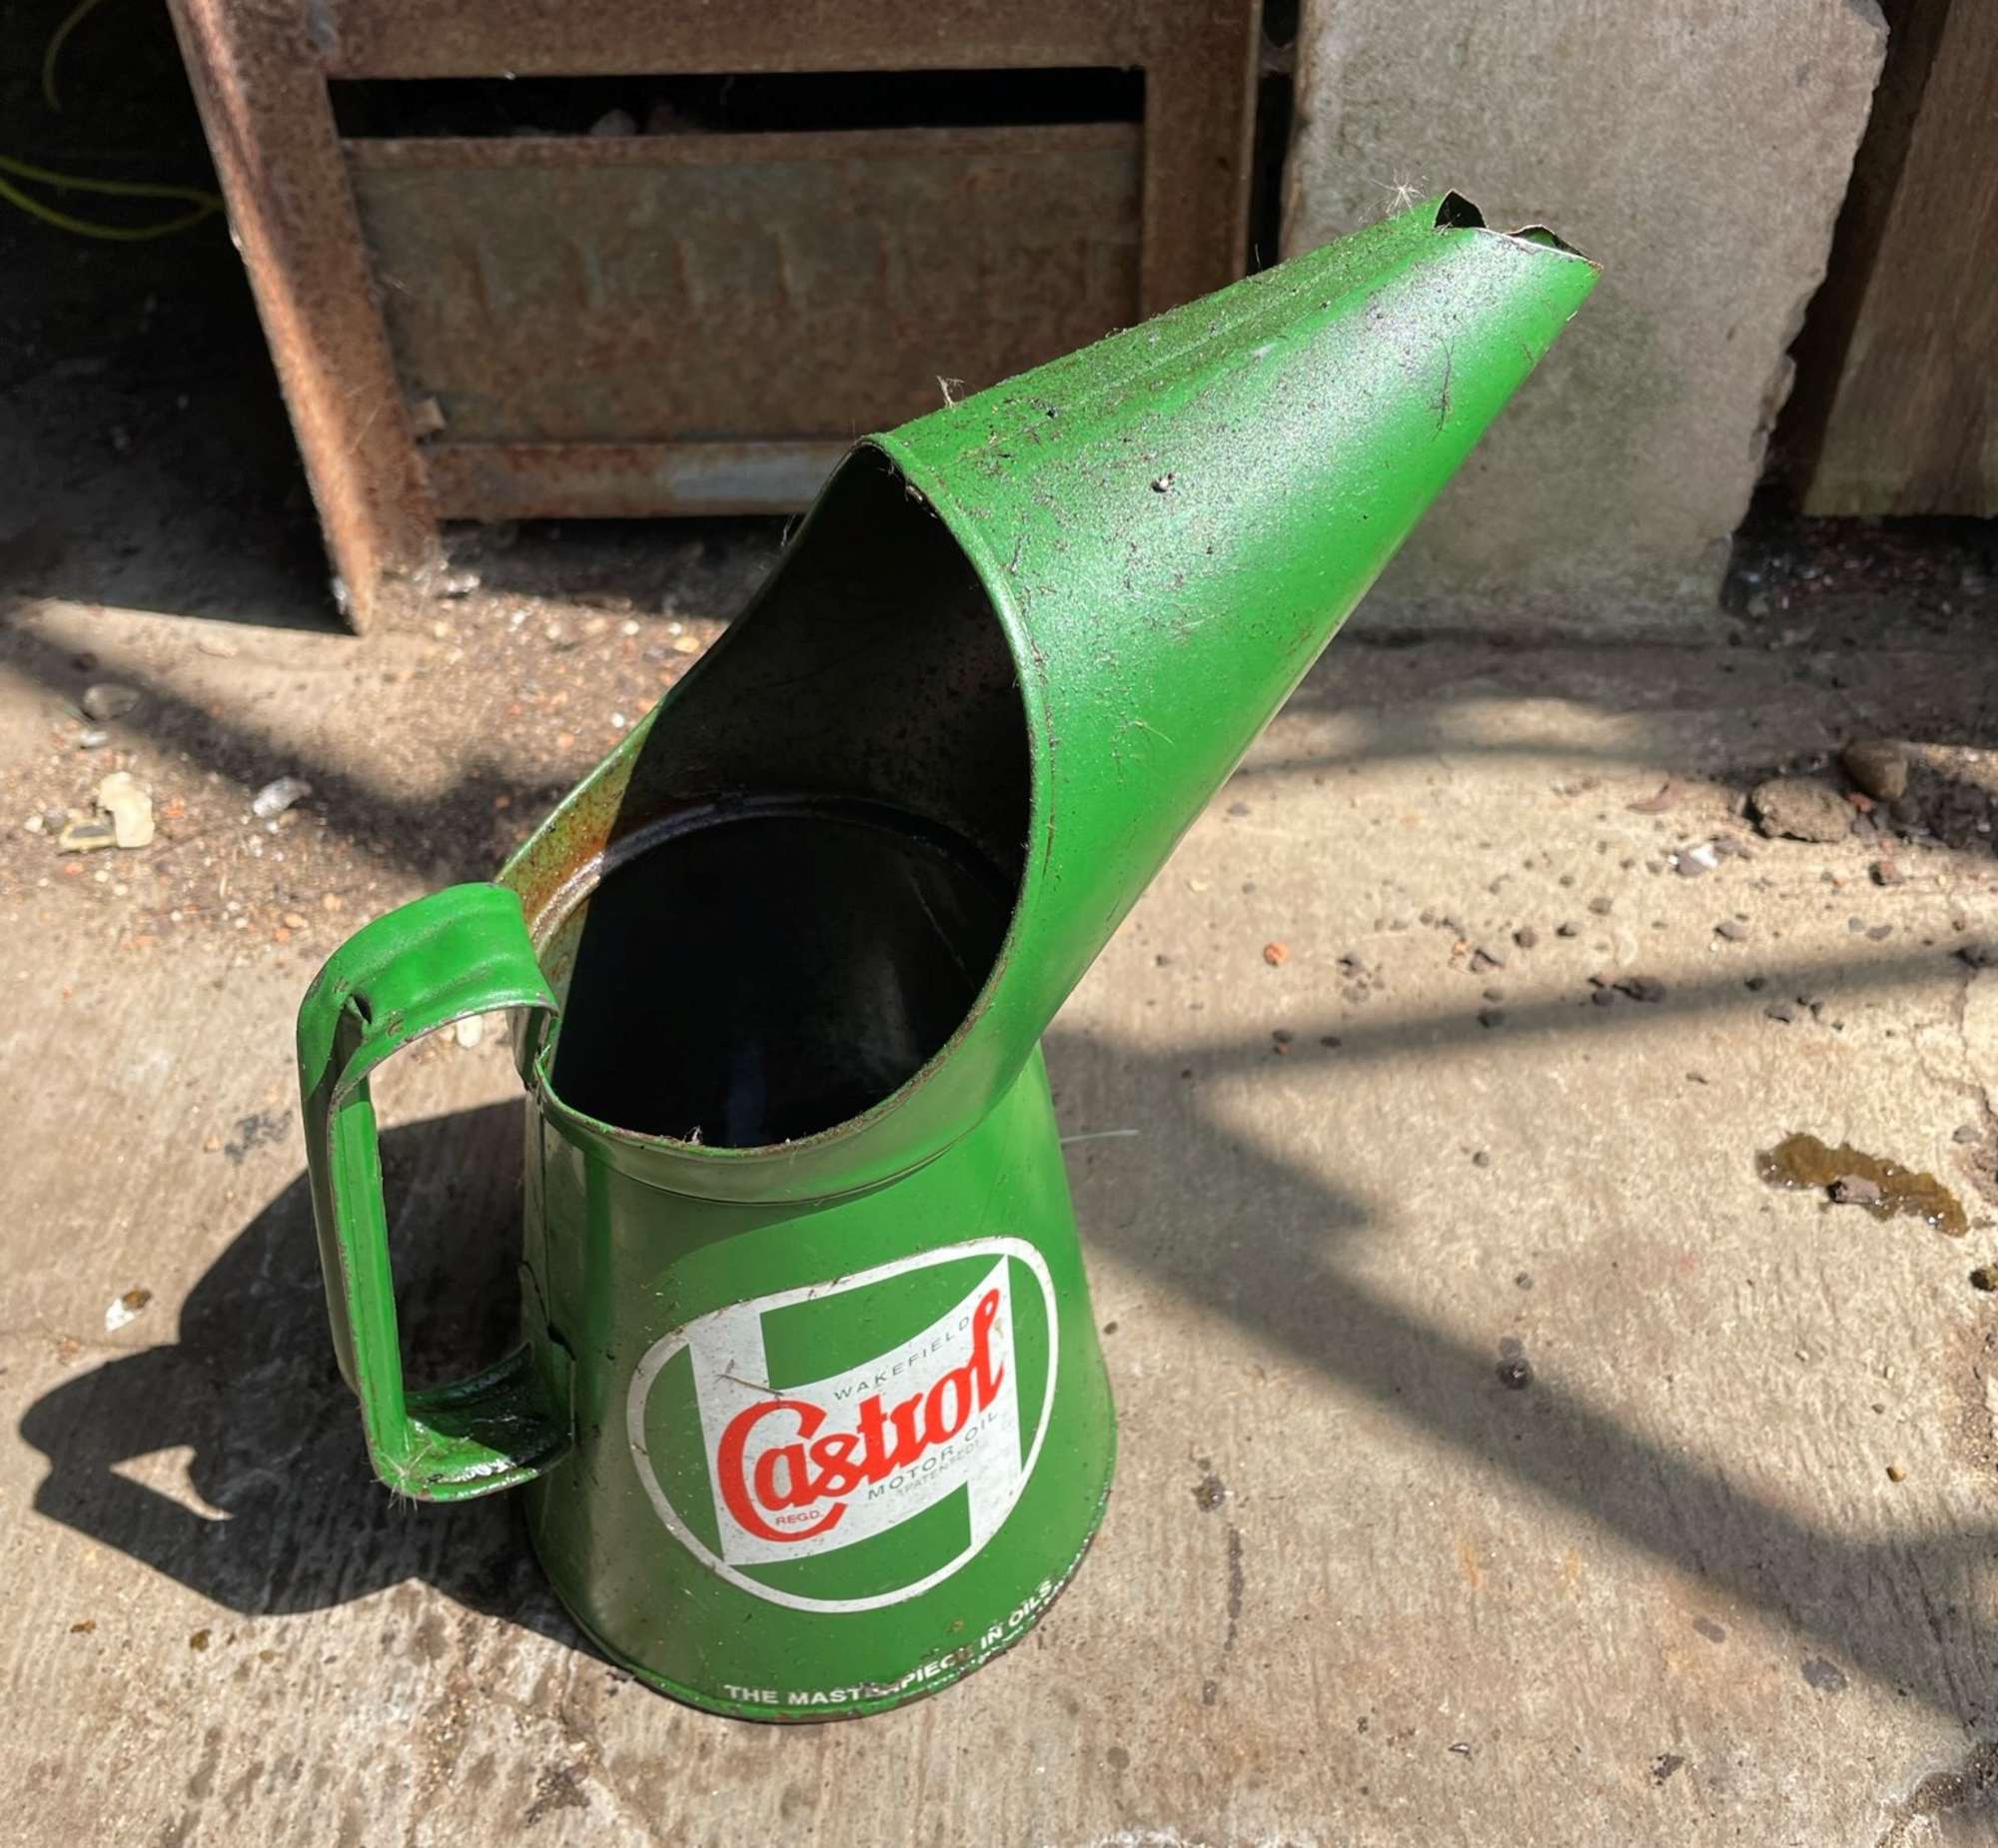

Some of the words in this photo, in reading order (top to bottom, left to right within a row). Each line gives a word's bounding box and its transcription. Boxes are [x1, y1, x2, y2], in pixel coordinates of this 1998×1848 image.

[833, 1316, 970, 1400] WAKEFIELD
[717, 1288, 1004, 1542] Castrol
[867, 1444, 954, 1499] MOTOR
[964, 1411, 998, 1442] OIL
[723, 1684, 778, 1705] THE
[787, 1645, 973, 1706] MASTPIEC
[980, 1625, 1003, 1650] IN
[1007, 1579, 1053, 1627] OILS
